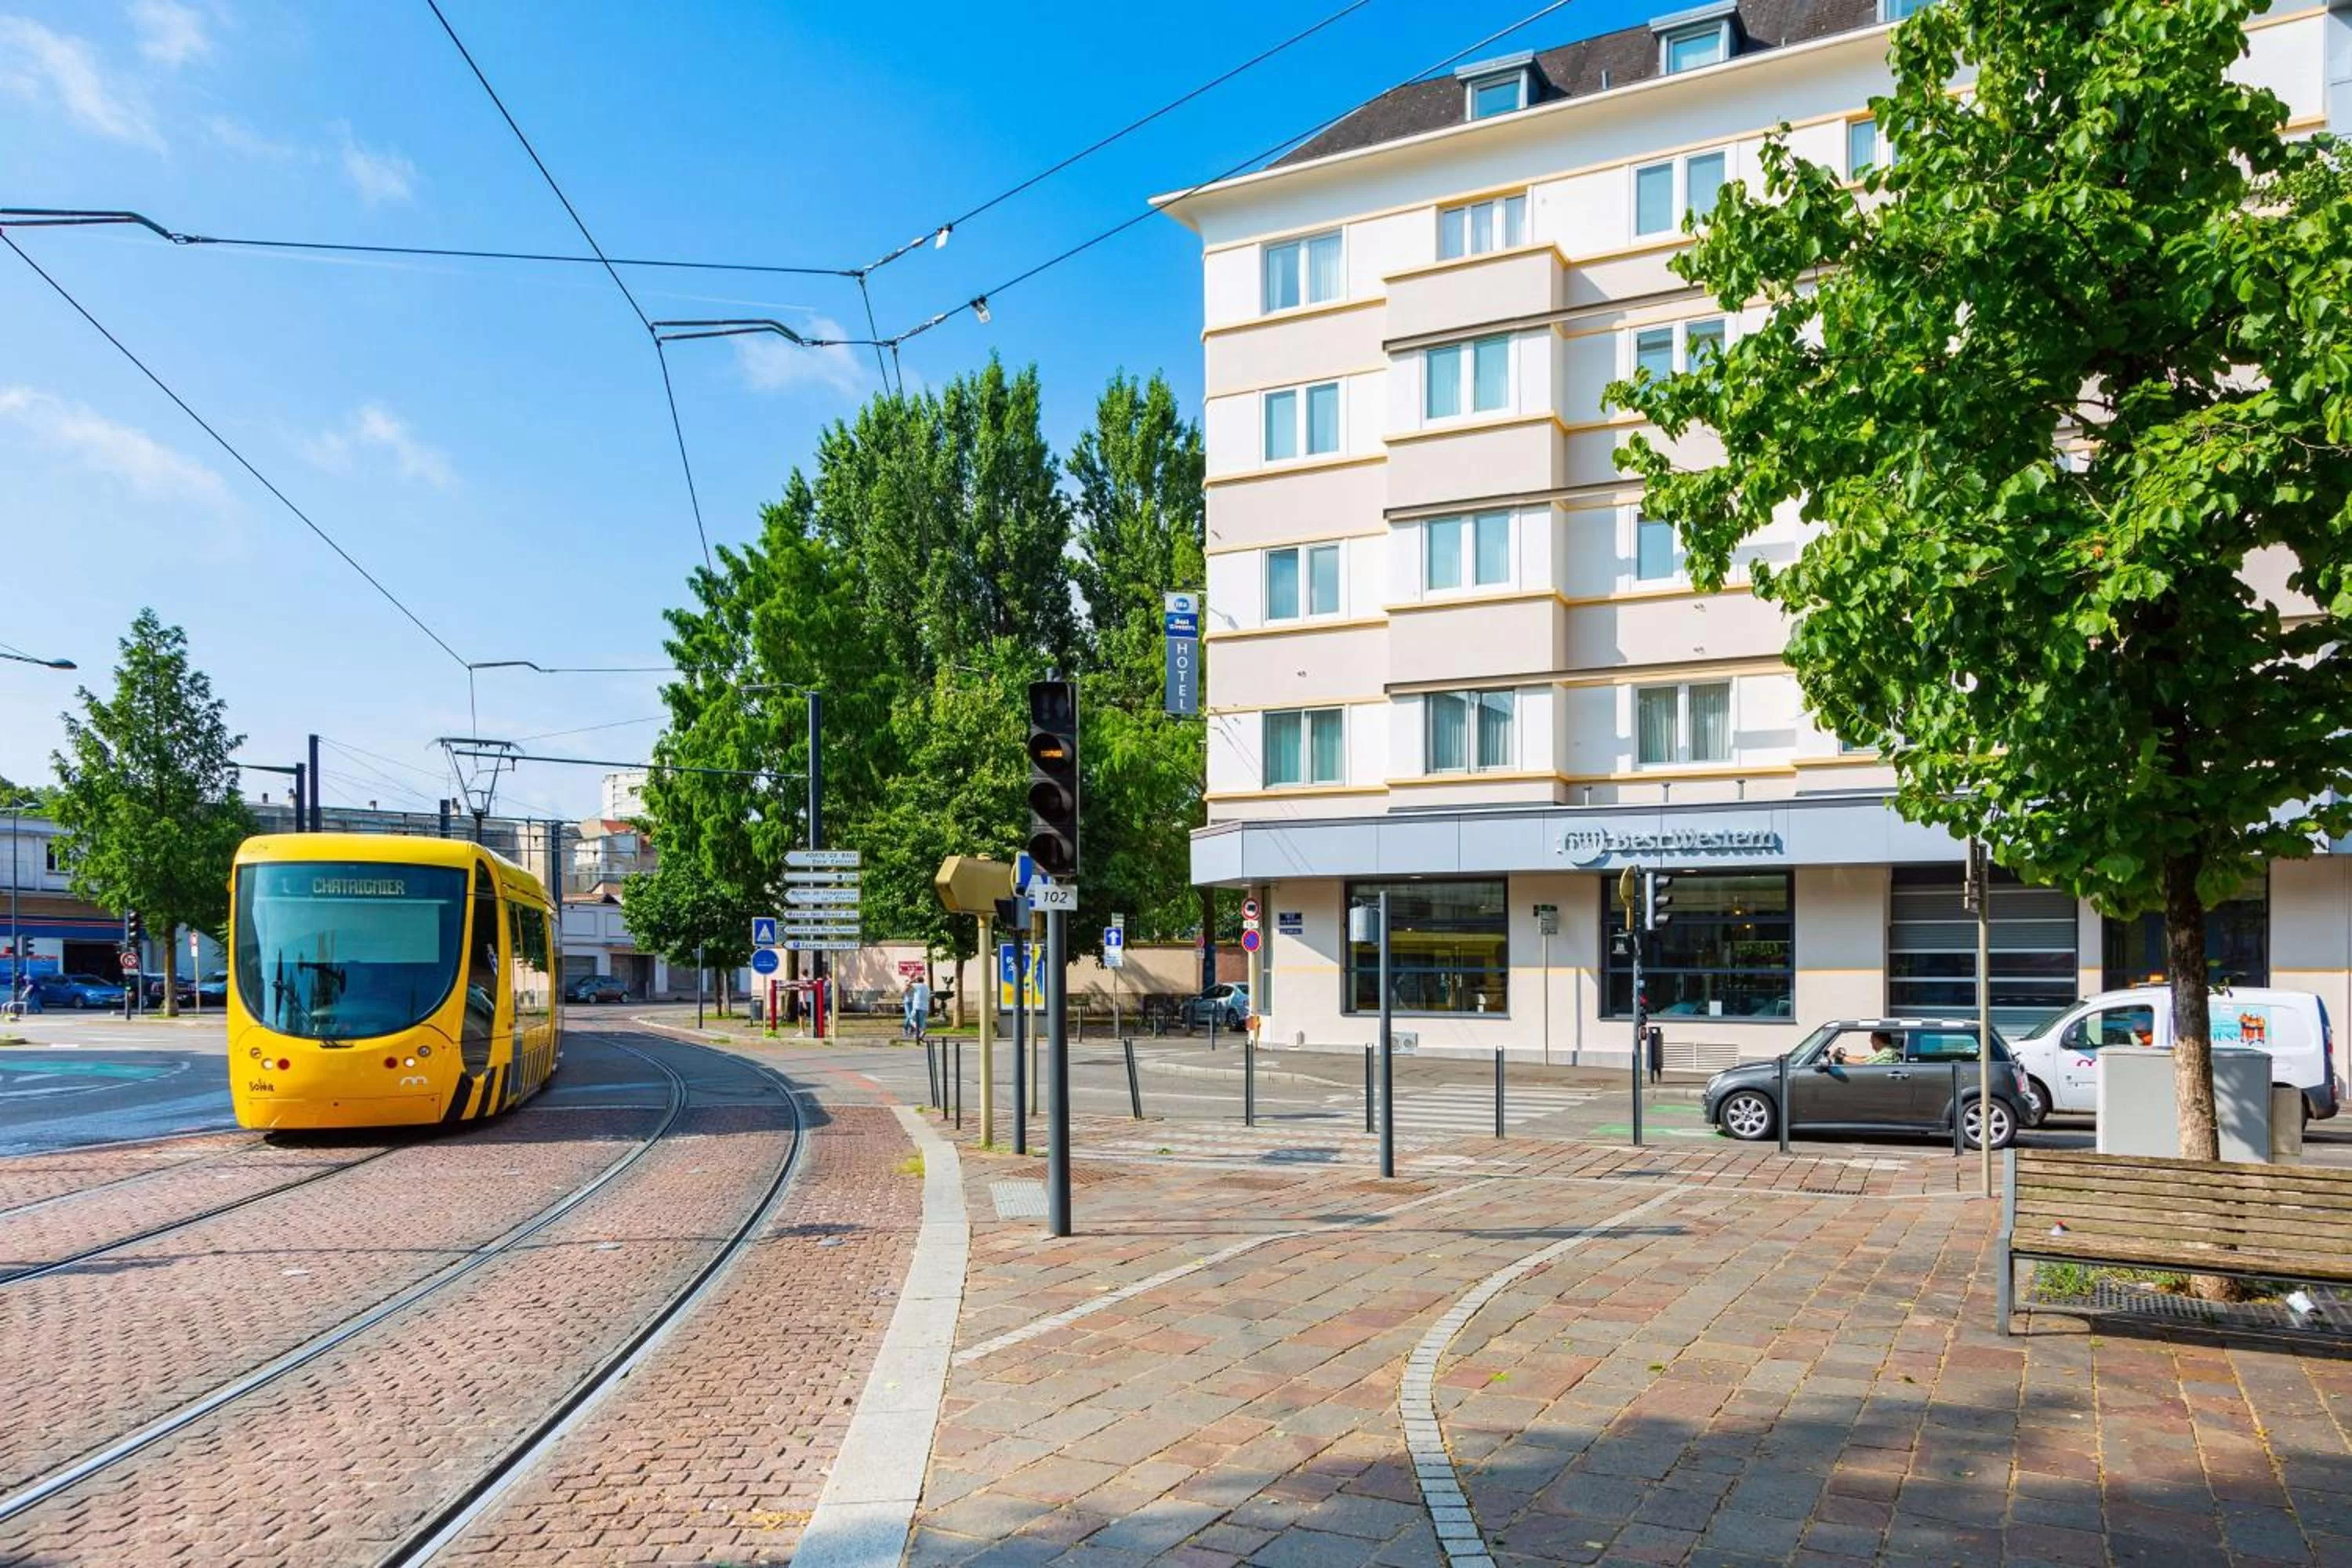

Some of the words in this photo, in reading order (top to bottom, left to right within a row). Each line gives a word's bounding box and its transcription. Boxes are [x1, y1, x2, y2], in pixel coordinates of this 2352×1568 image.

[1177, 643, 1188, 710] HOTEL
[1671, 827, 1776, 849] Western
[313, 877, 406, 895] CHATAIGNIER
[1044, 891, 1068, 904] 102
